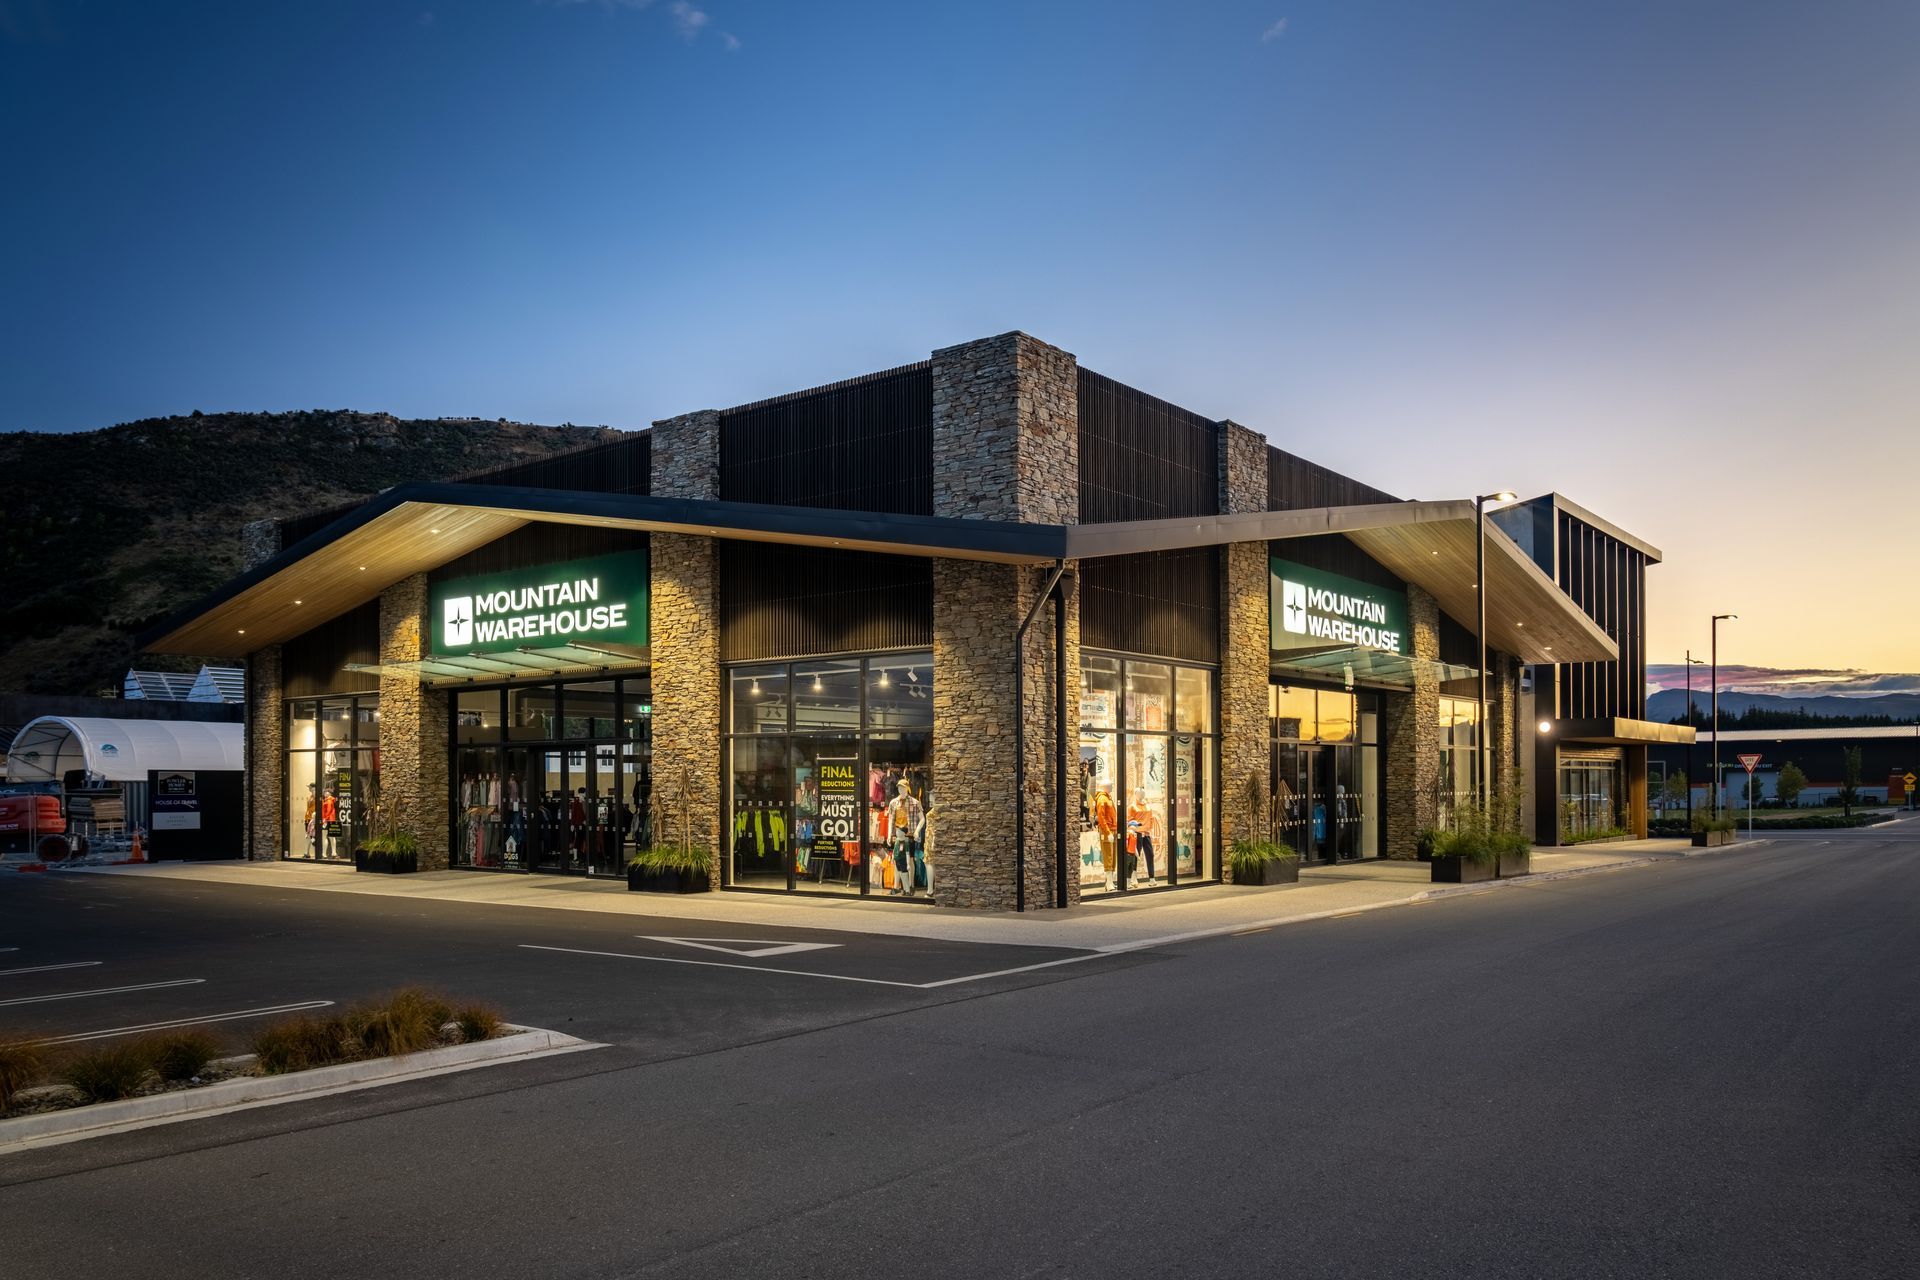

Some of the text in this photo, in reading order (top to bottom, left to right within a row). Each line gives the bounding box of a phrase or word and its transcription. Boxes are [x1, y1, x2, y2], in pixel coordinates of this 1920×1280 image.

[475, 577, 598, 616] MOUNTAIN
[1308, 586, 1386, 624] MOUNTAIN
[475, 603, 627, 643] WAREHOUSE
[1307, 614, 1400, 652] WAREHOUSE
[821, 765, 855, 778] FINAL
[339, 799, 352, 809] MUS
[820, 804, 855, 818] MUST
[339, 809, 352, 823] GO
[820, 818, 855, 838] GO!
